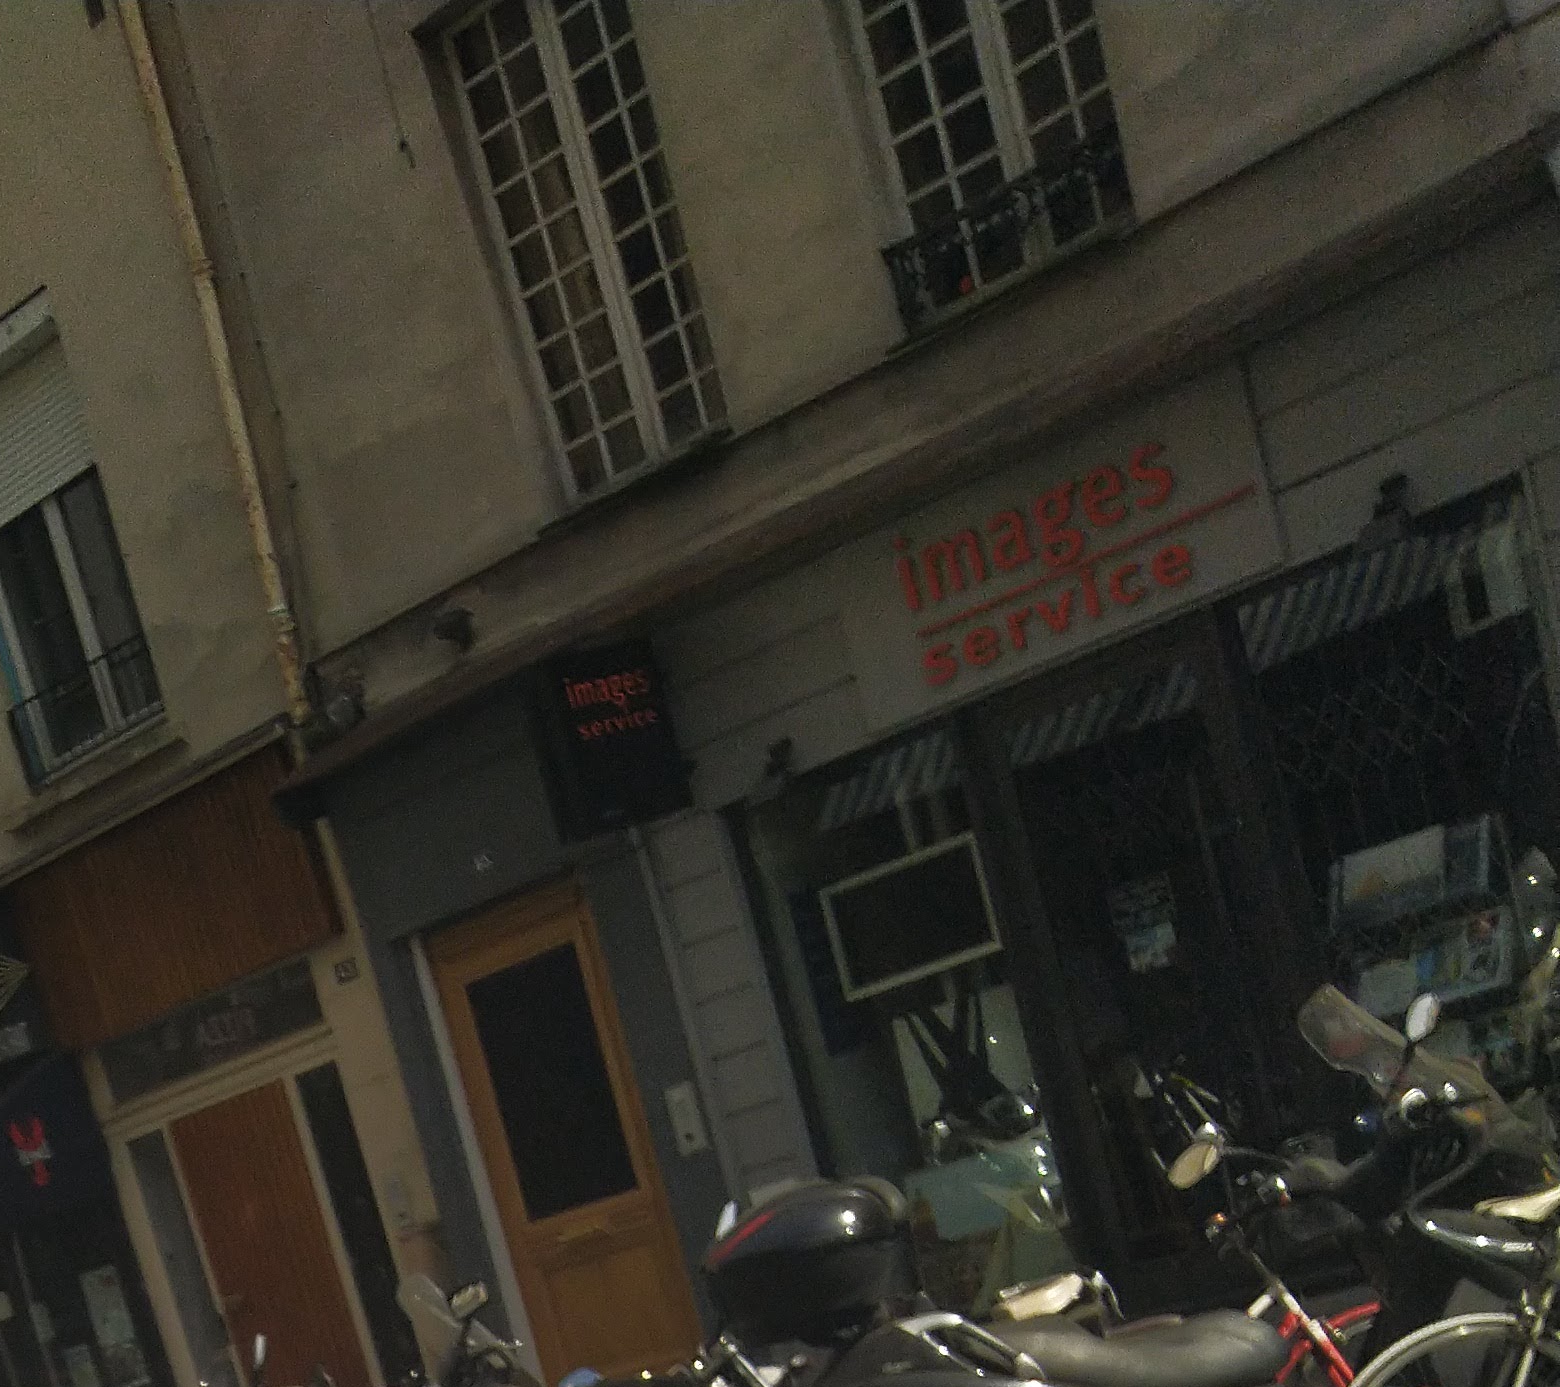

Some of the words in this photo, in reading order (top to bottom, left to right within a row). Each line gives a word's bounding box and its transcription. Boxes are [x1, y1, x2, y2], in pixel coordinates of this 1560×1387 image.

[895, 442, 1174, 611] images
[922, 544, 1193, 686] service
[564, 670, 649, 709] images
[579, 710, 659, 740] service
